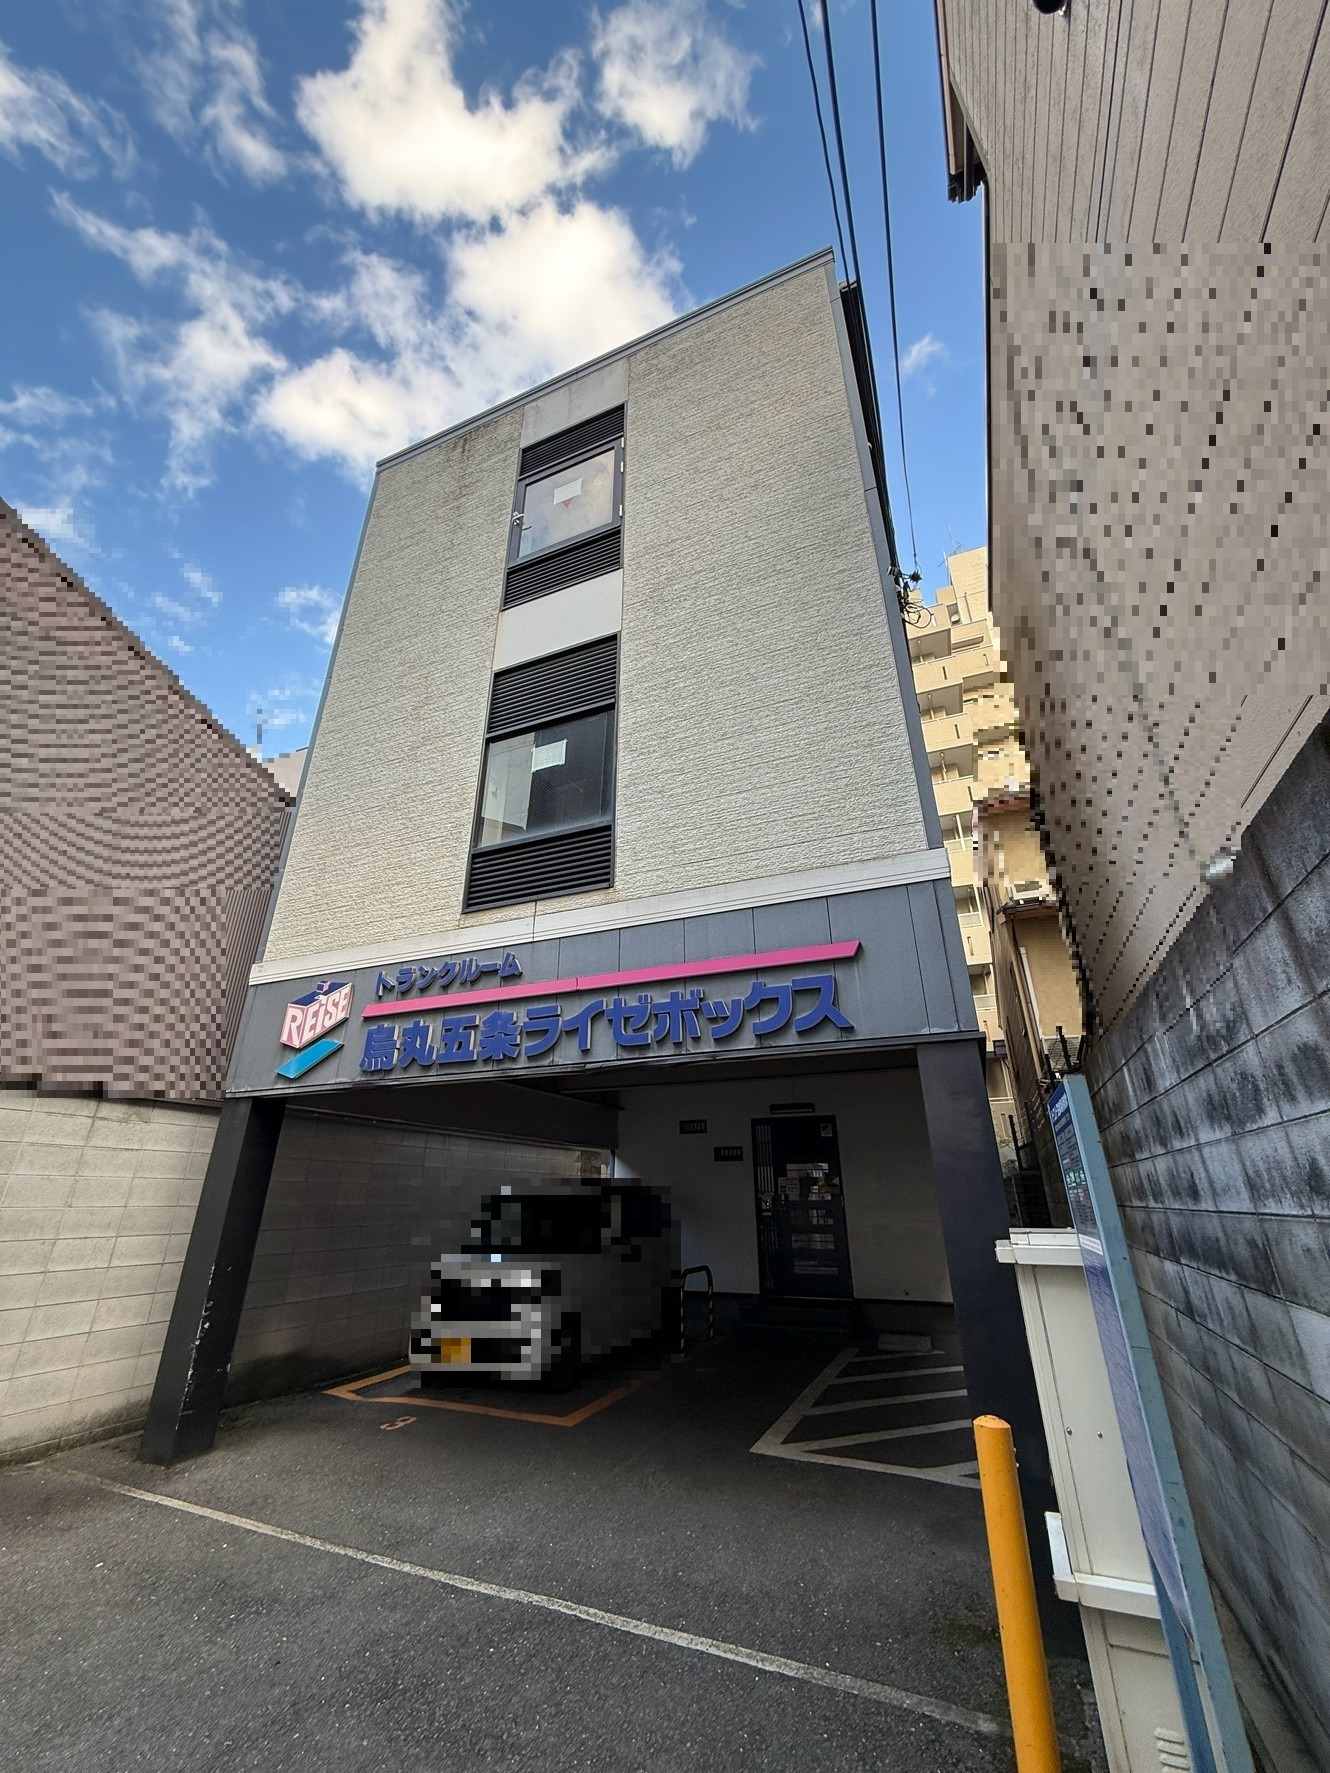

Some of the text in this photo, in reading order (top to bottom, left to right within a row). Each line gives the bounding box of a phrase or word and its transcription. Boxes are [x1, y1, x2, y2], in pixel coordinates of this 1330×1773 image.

[376, 952, 523, 998] トランクルーム
[359, 974, 854, 1072] 烏丸五条ライゼボックス
